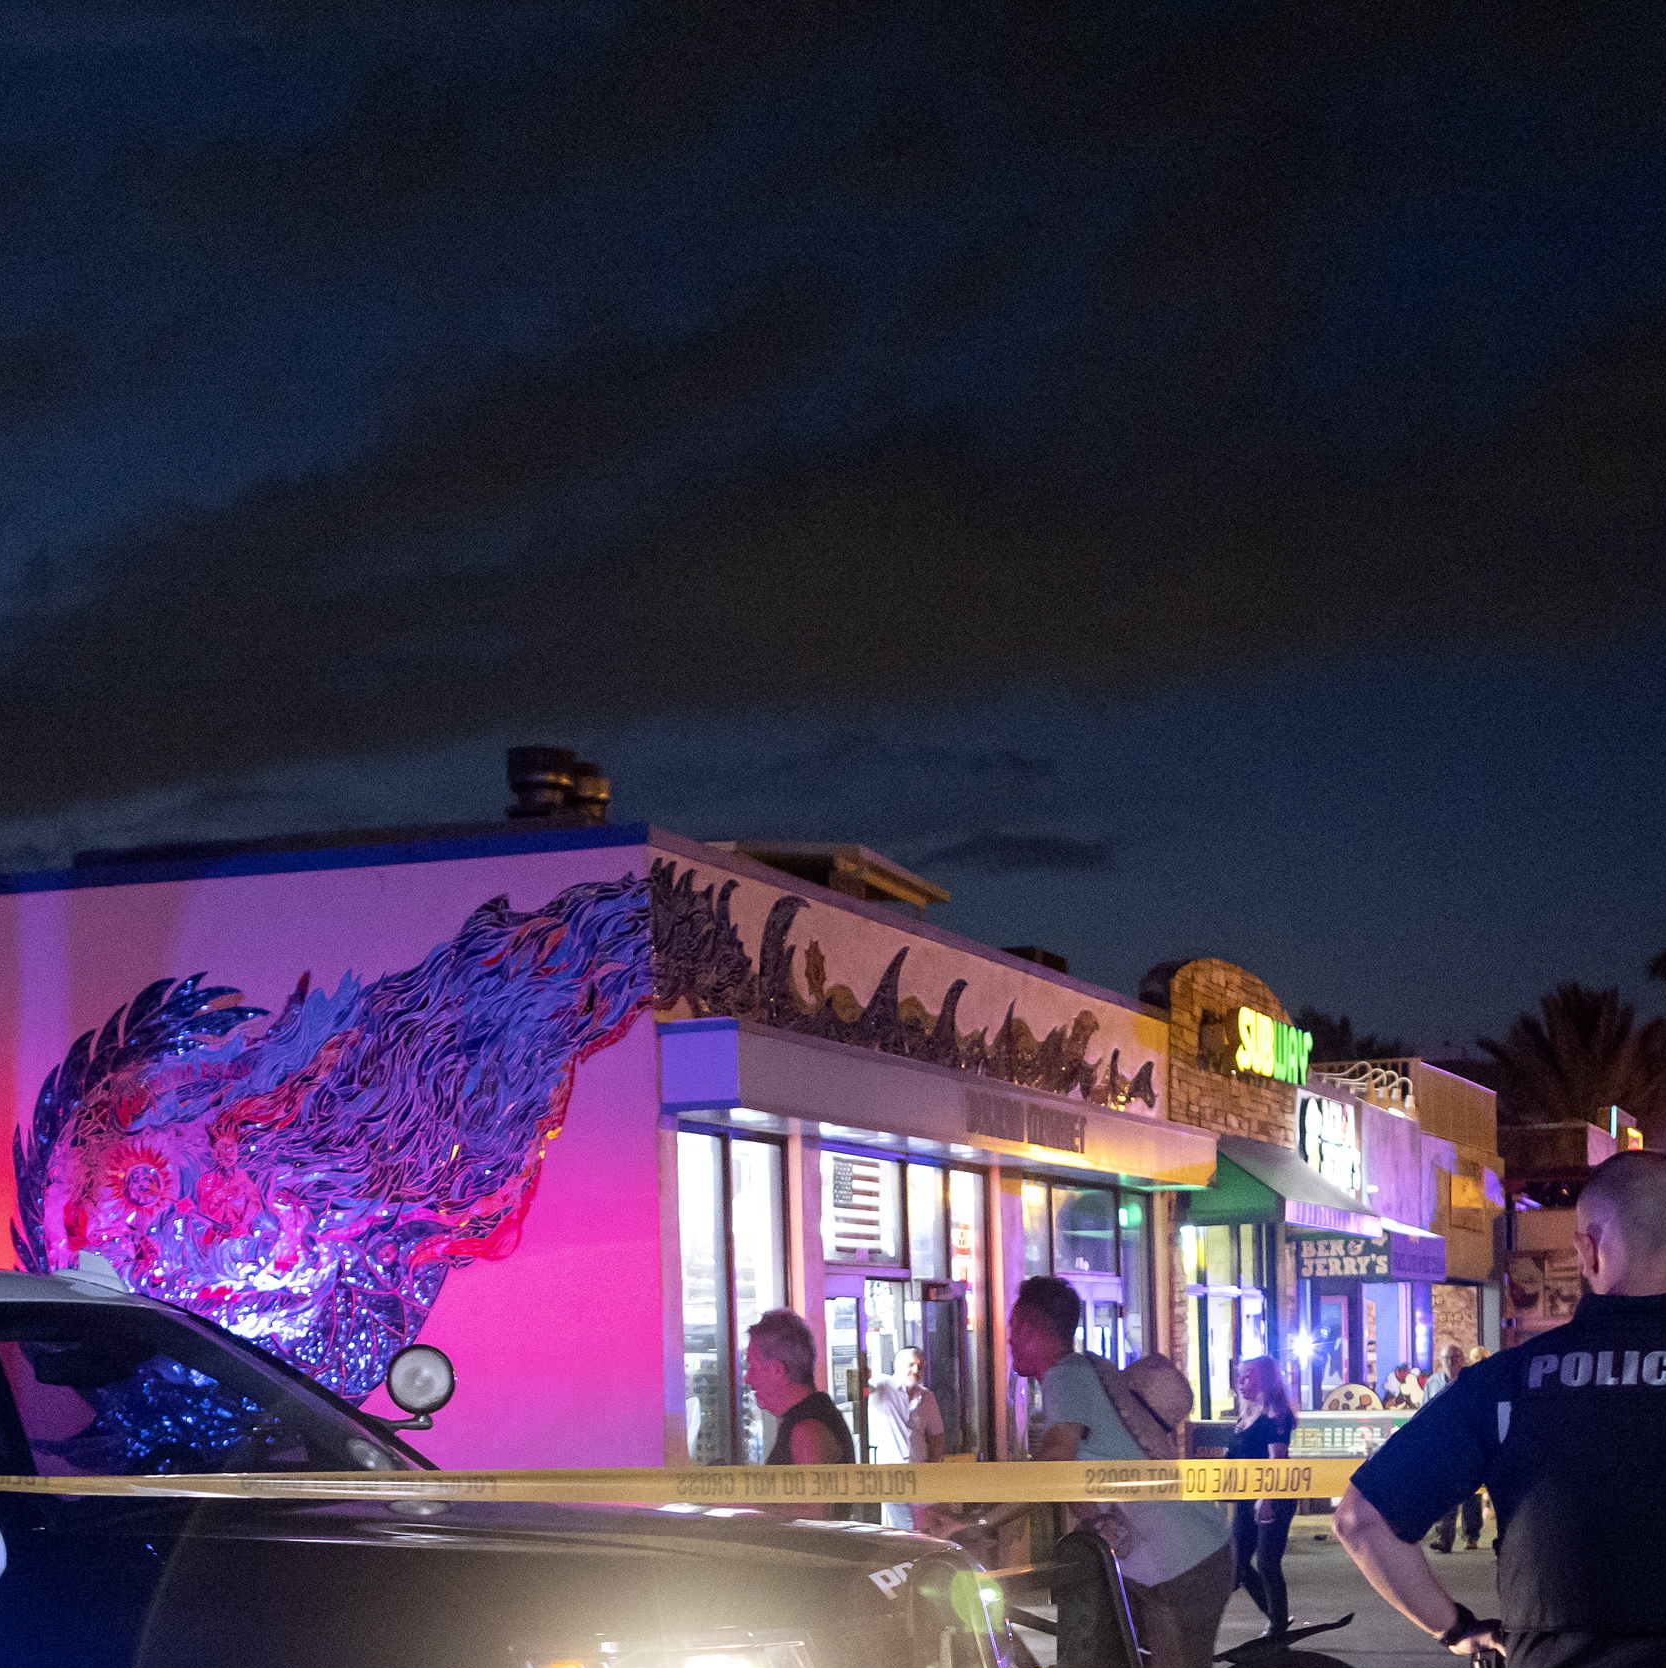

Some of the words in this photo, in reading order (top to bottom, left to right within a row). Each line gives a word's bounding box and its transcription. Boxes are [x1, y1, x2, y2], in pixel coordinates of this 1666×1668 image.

[1235, 1006, 1314, 1086] SUBWAY
[1300, 1239, 1345, 1258] BEN
[1347, 1239, 1366, 1256] &
[1300, 1253, 1389, 1277] JERRY'S
